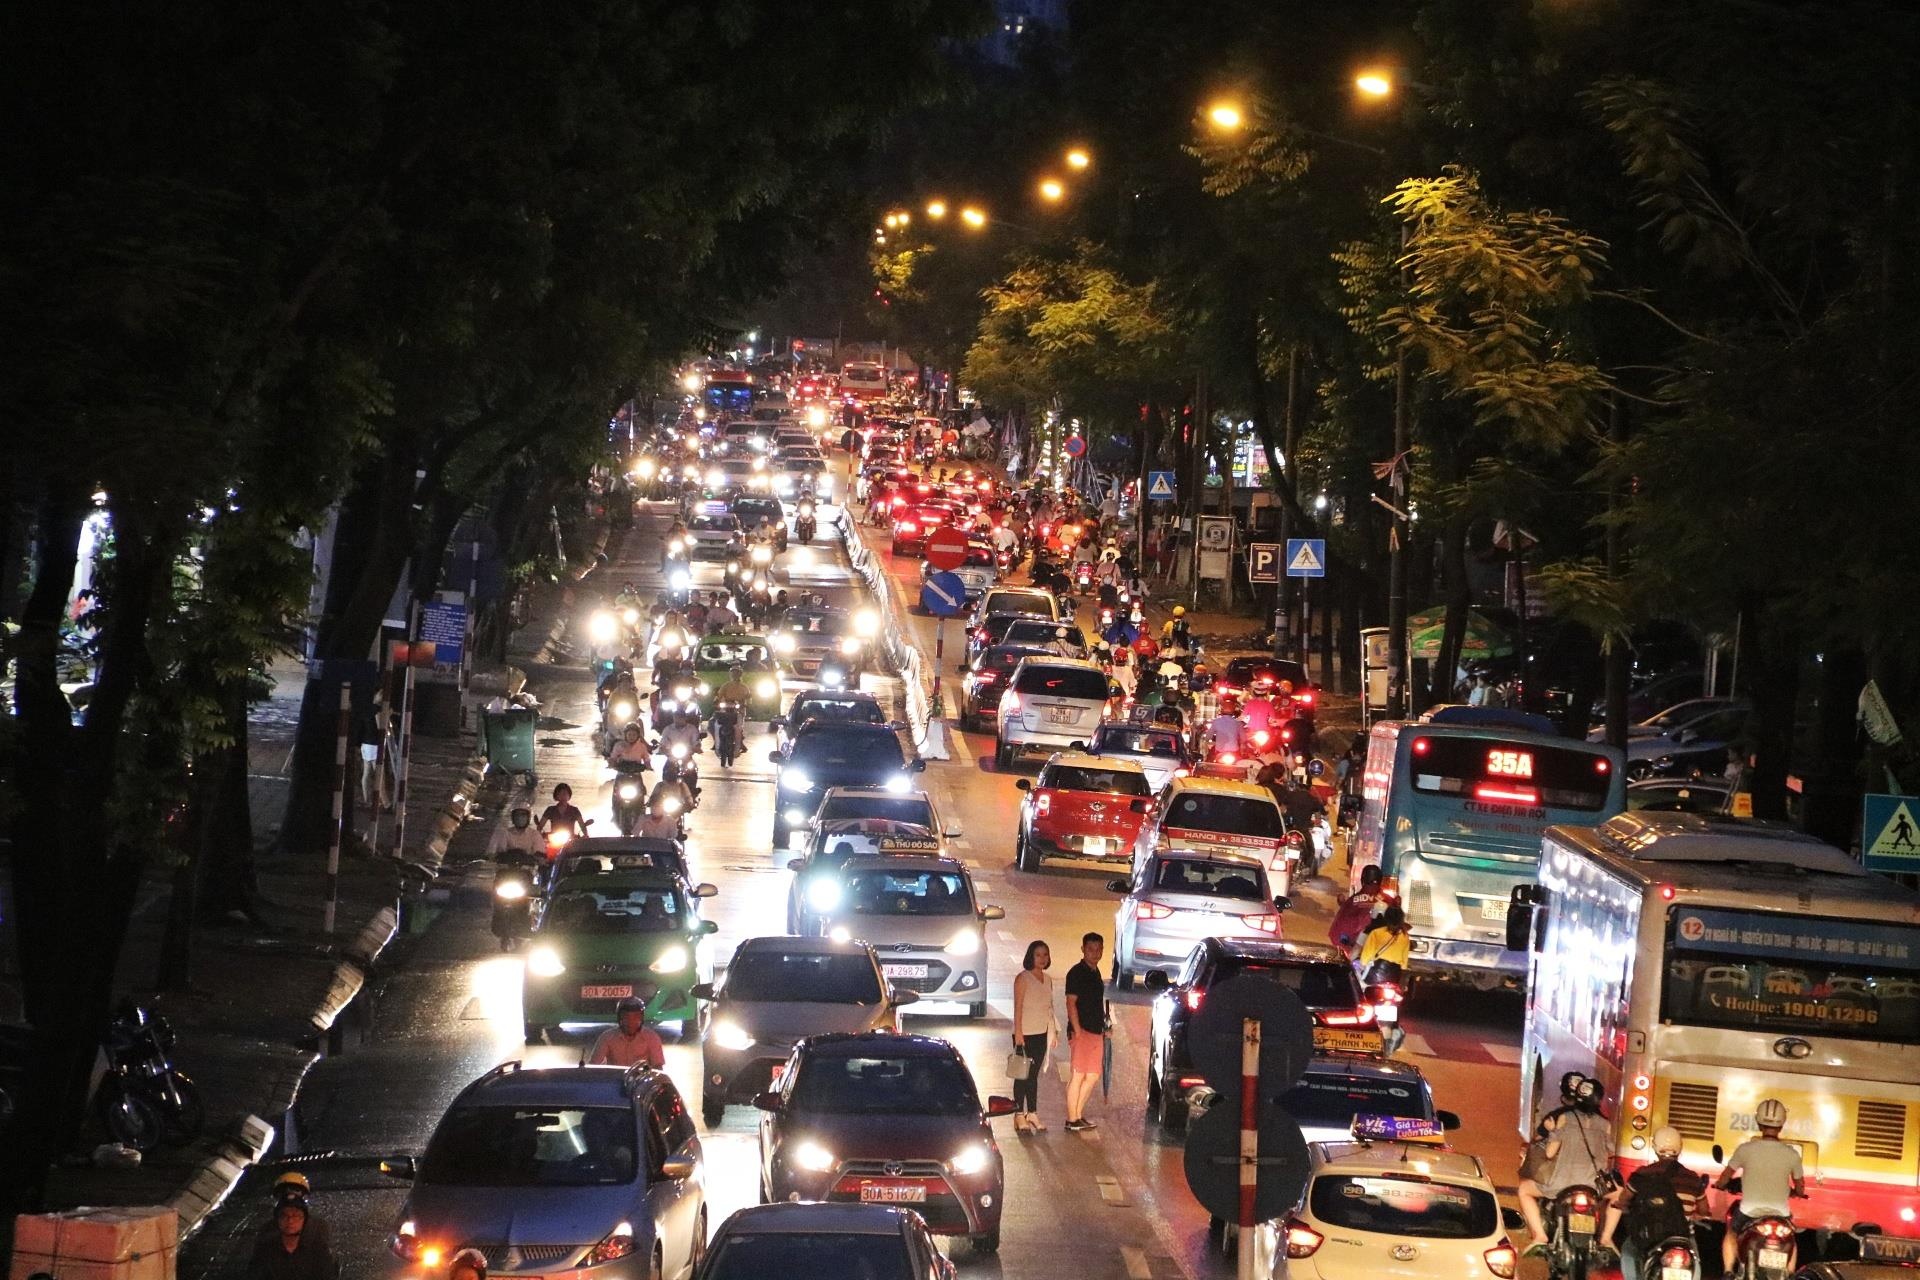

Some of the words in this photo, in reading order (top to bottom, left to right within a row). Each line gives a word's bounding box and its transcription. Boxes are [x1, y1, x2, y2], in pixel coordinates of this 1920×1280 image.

[1257, 551, 1273, 571] P
[1488, 750, 1532, 777] 35A
[1184, 831, 1216, 841] HANOI
[1684, 921, 1702, 935] 12
[1726, 996, 1780, 1014] Hotline:
[1783, 1002, 1878, 1024] 1900.1296
[1345, 1032, 1364, 1040] TAXI
[1331, 1039, 1360, 1048] THANH
[1396, 1121, 1410, 1130] Giá
[1344, 1186, 1363, 1195] 198
[1870, 1240, 1915, 1259] VINA
